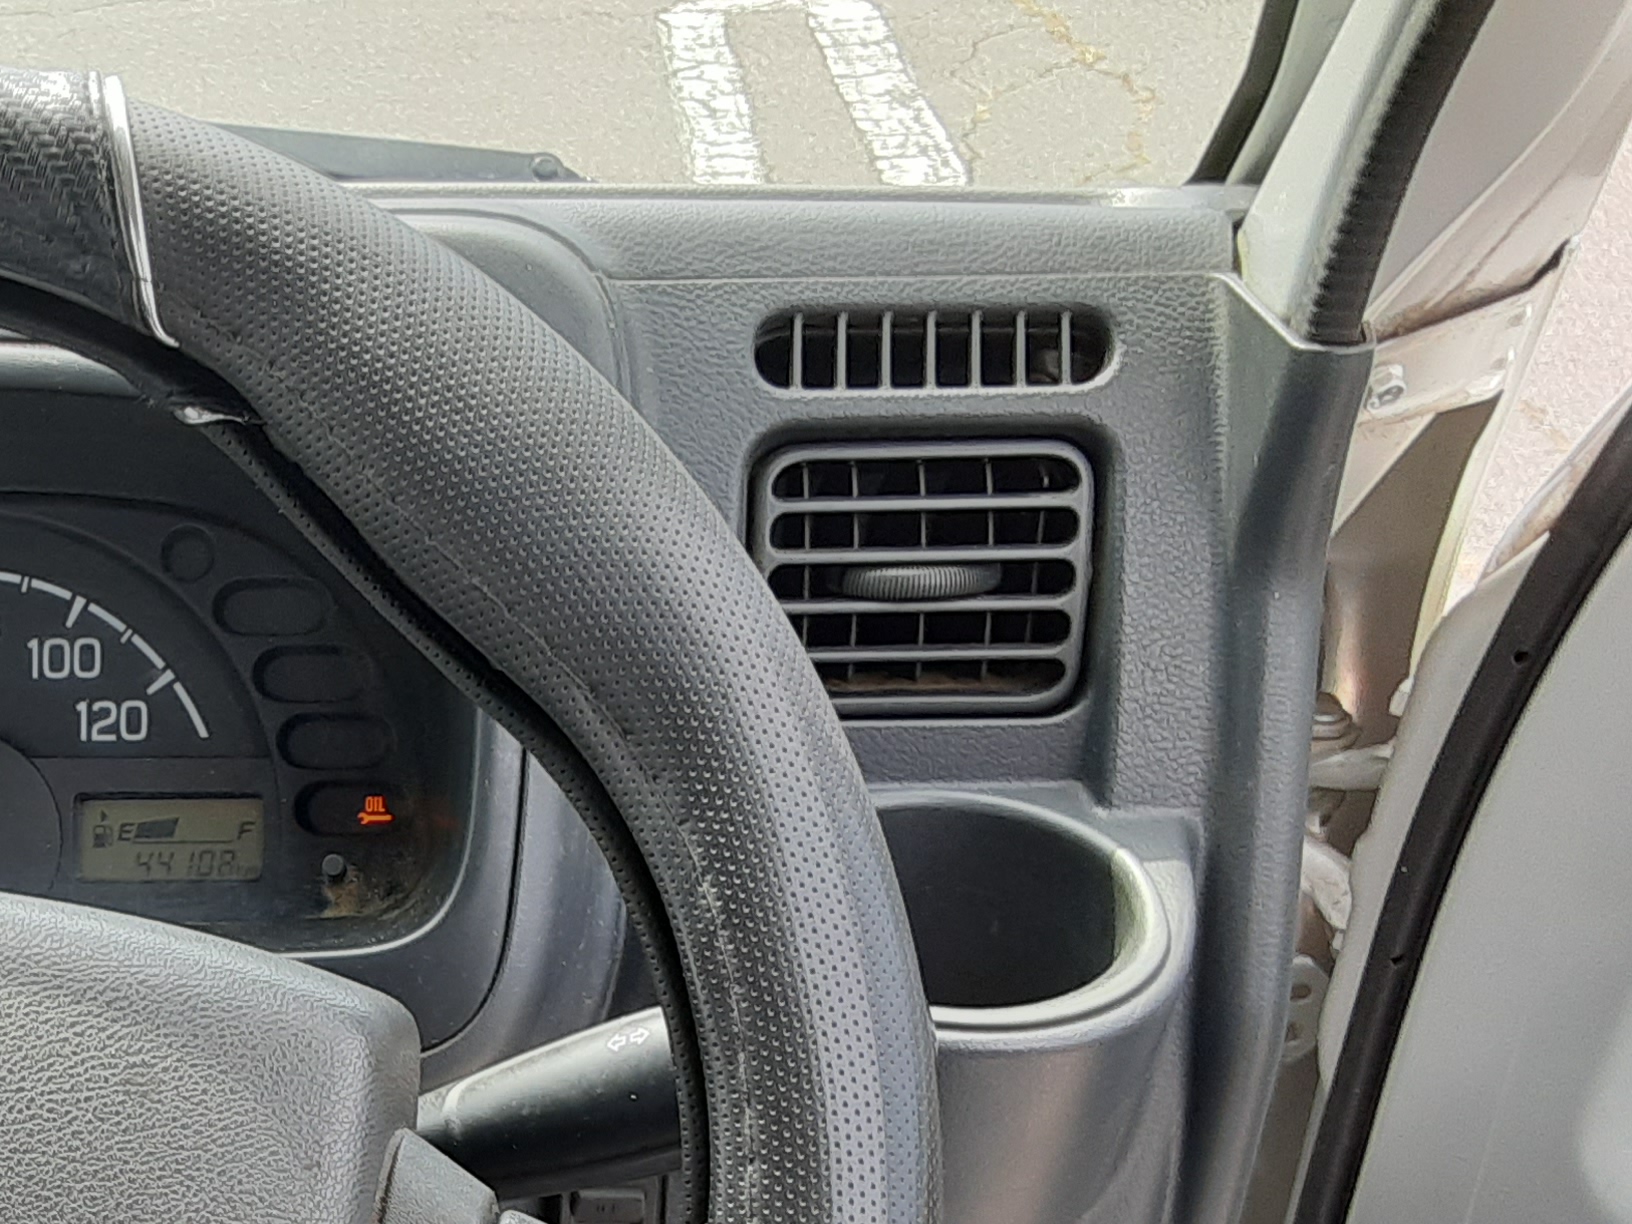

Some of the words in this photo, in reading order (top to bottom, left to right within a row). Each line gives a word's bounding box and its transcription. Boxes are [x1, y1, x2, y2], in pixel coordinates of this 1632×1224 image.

[27, 638, 102, 679] 100
[75, 699, 148, 742] 120
[365, 795, 386, 812] OIL
[118, 822, 135, 841] E
[237, 821, 256, 840] F
